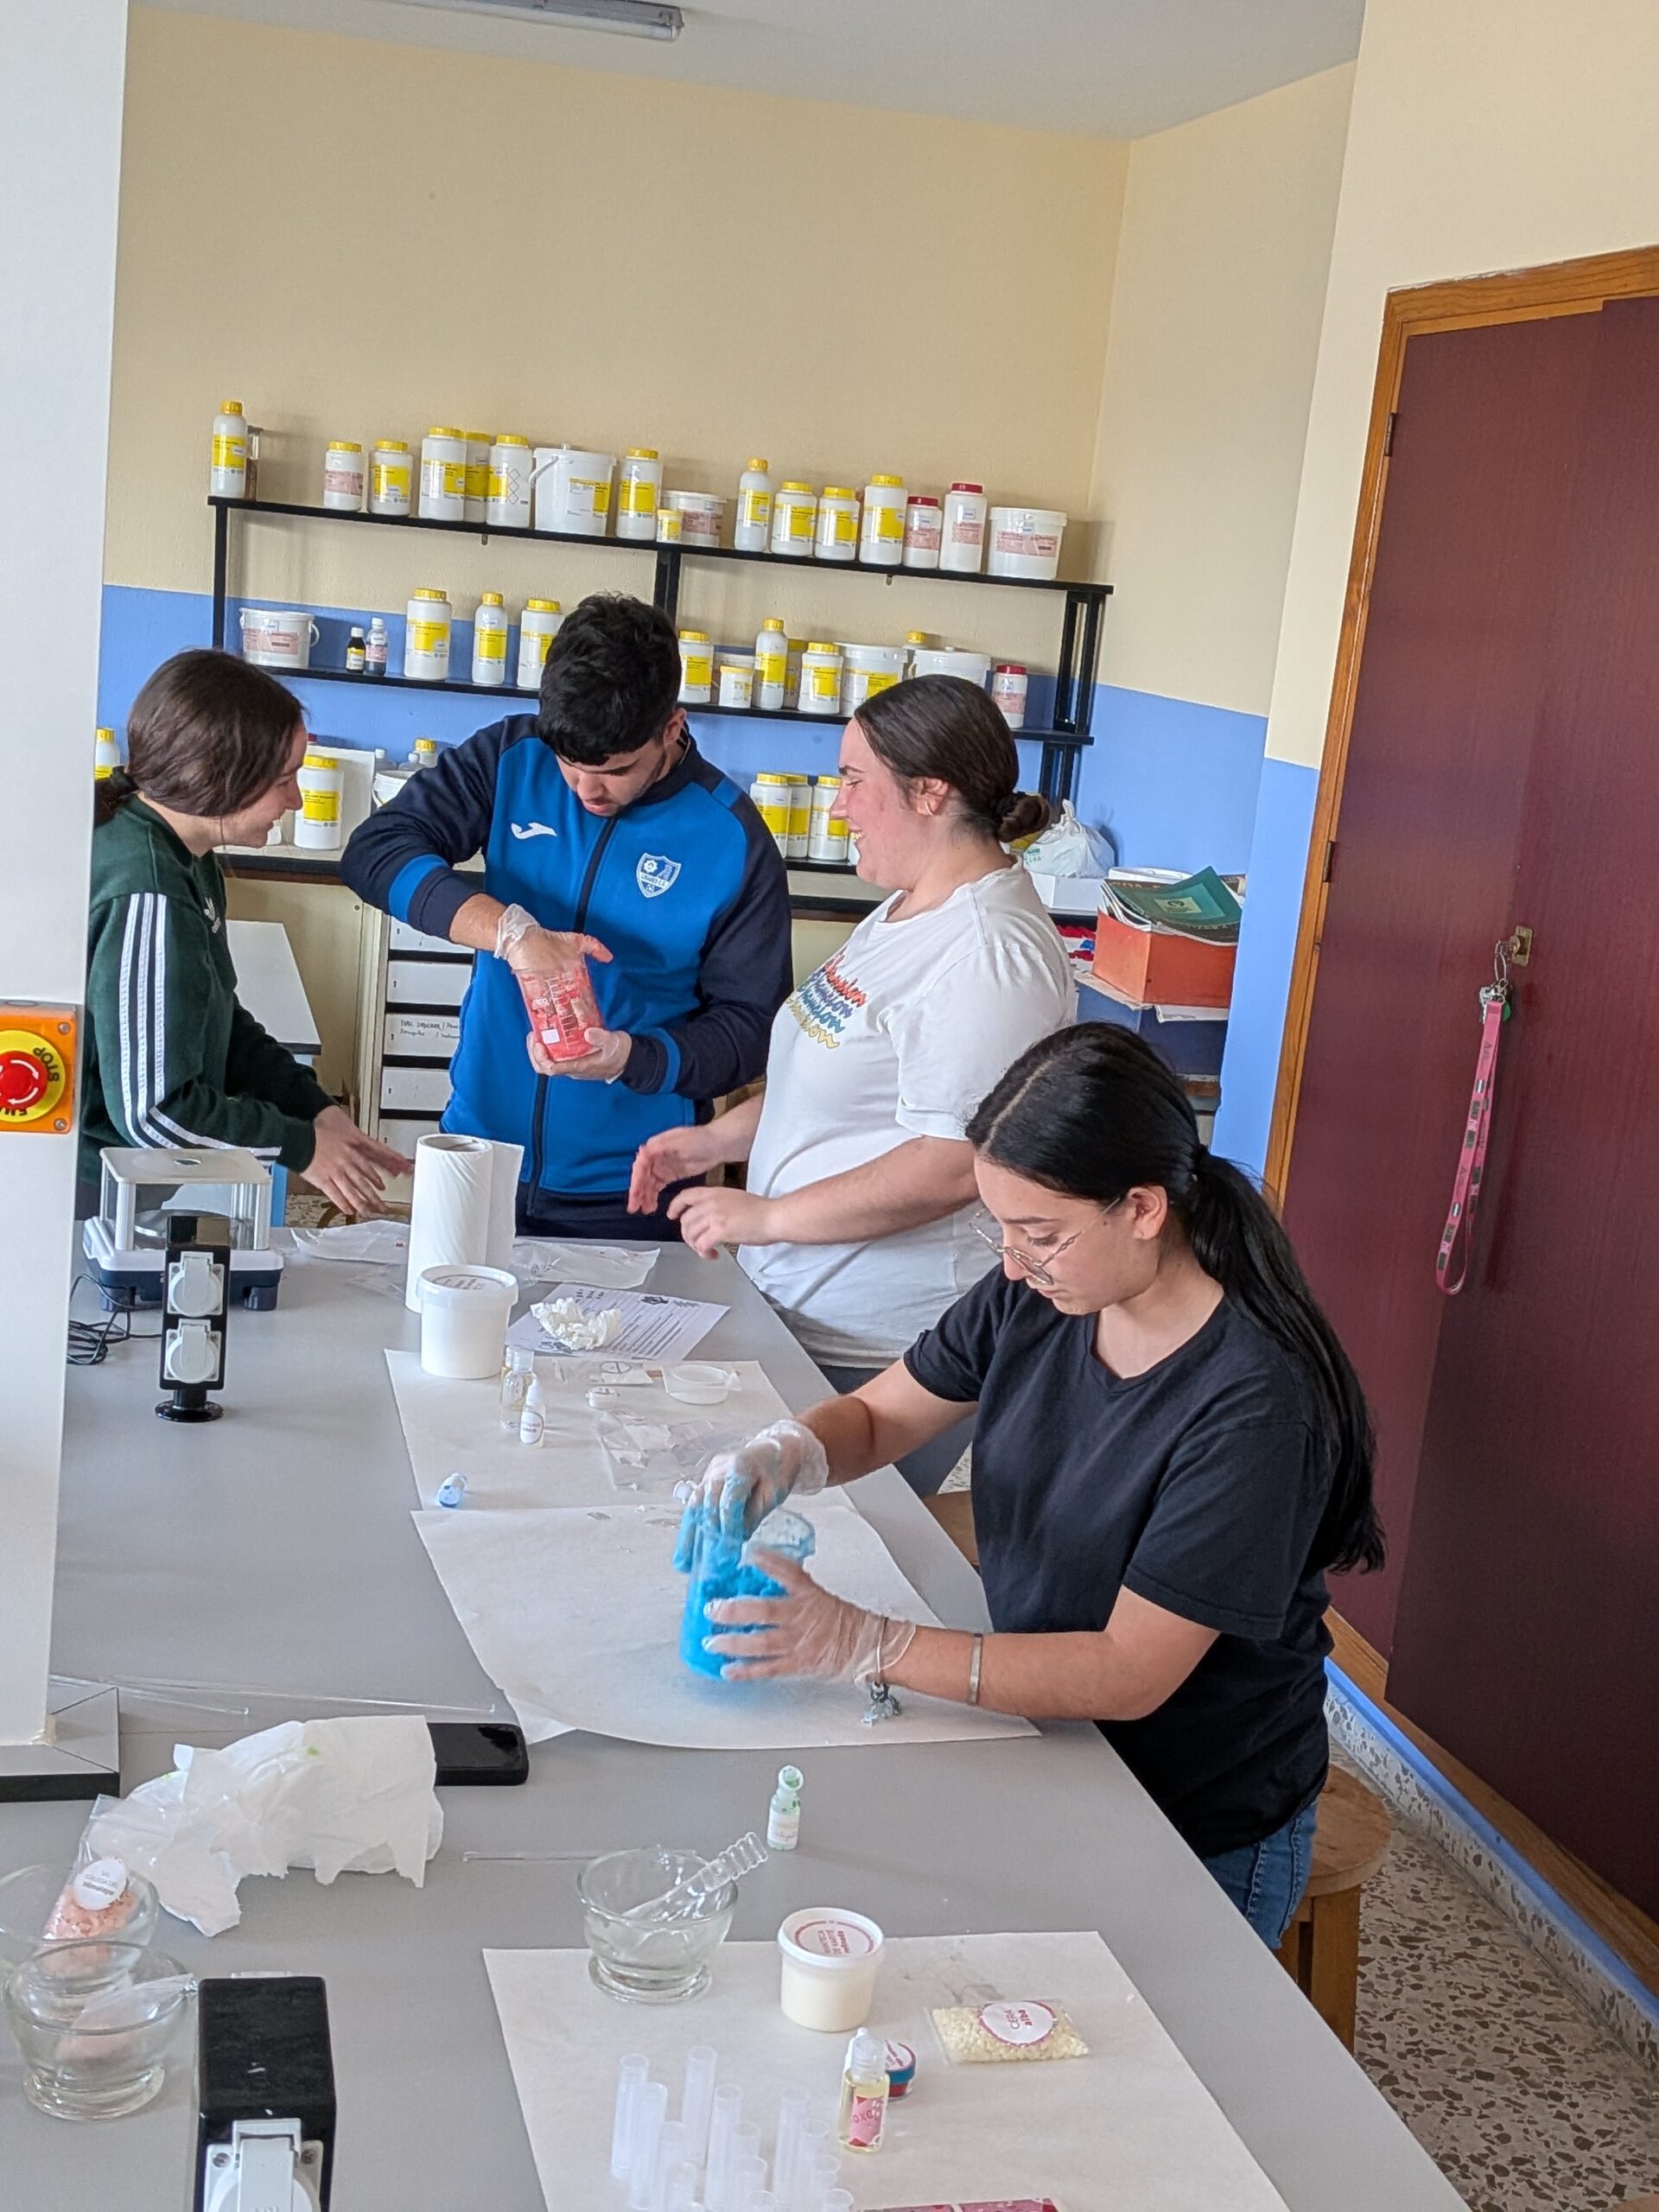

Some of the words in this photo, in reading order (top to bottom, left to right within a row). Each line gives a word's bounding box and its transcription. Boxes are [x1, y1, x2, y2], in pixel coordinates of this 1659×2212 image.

[33, 1046, 60, 1083] STOP
[1003, 2010, 1020, 2030] CERA
[1018, 2009, 1033, 2026] alba
